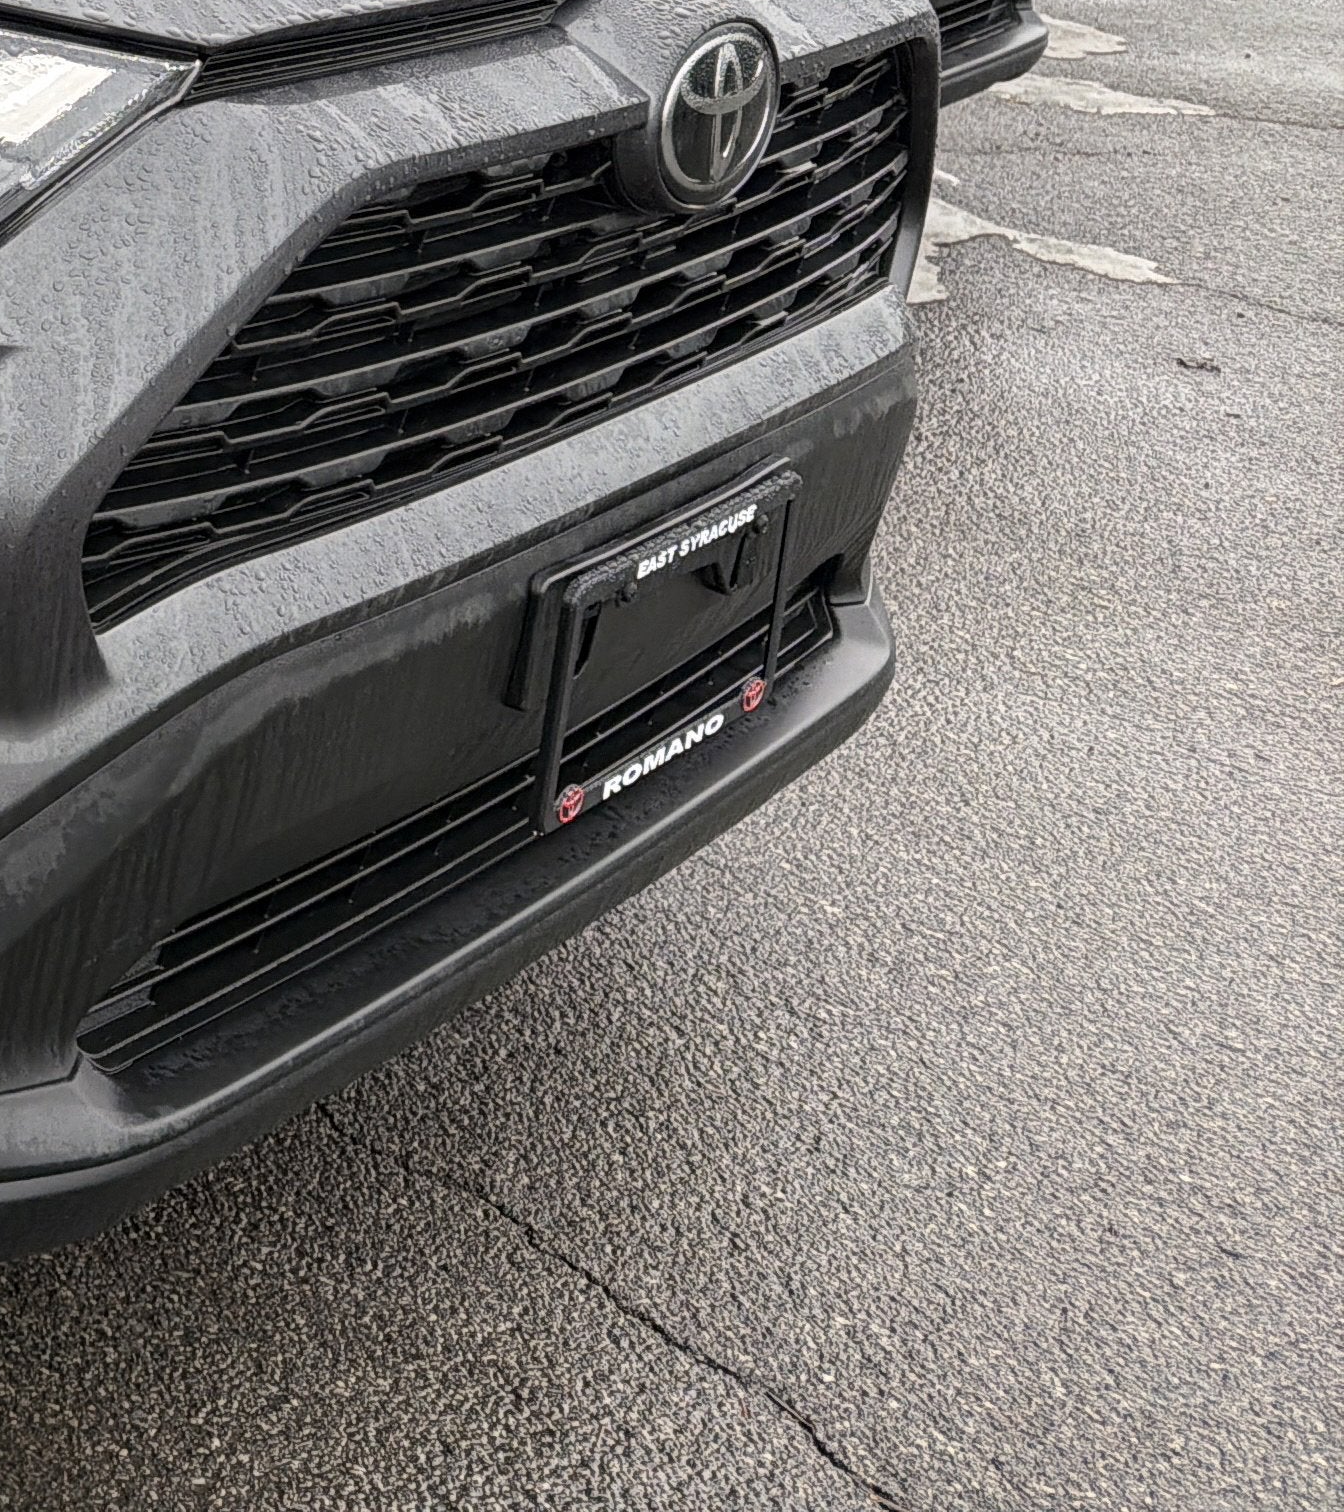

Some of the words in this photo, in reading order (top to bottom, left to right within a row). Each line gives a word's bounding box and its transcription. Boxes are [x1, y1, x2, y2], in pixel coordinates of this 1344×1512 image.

[637, 545, 678, 579] EAST
[678, 504, 758, 557] SYRACUSE
[602, 714, 725, 801] ROMANO
